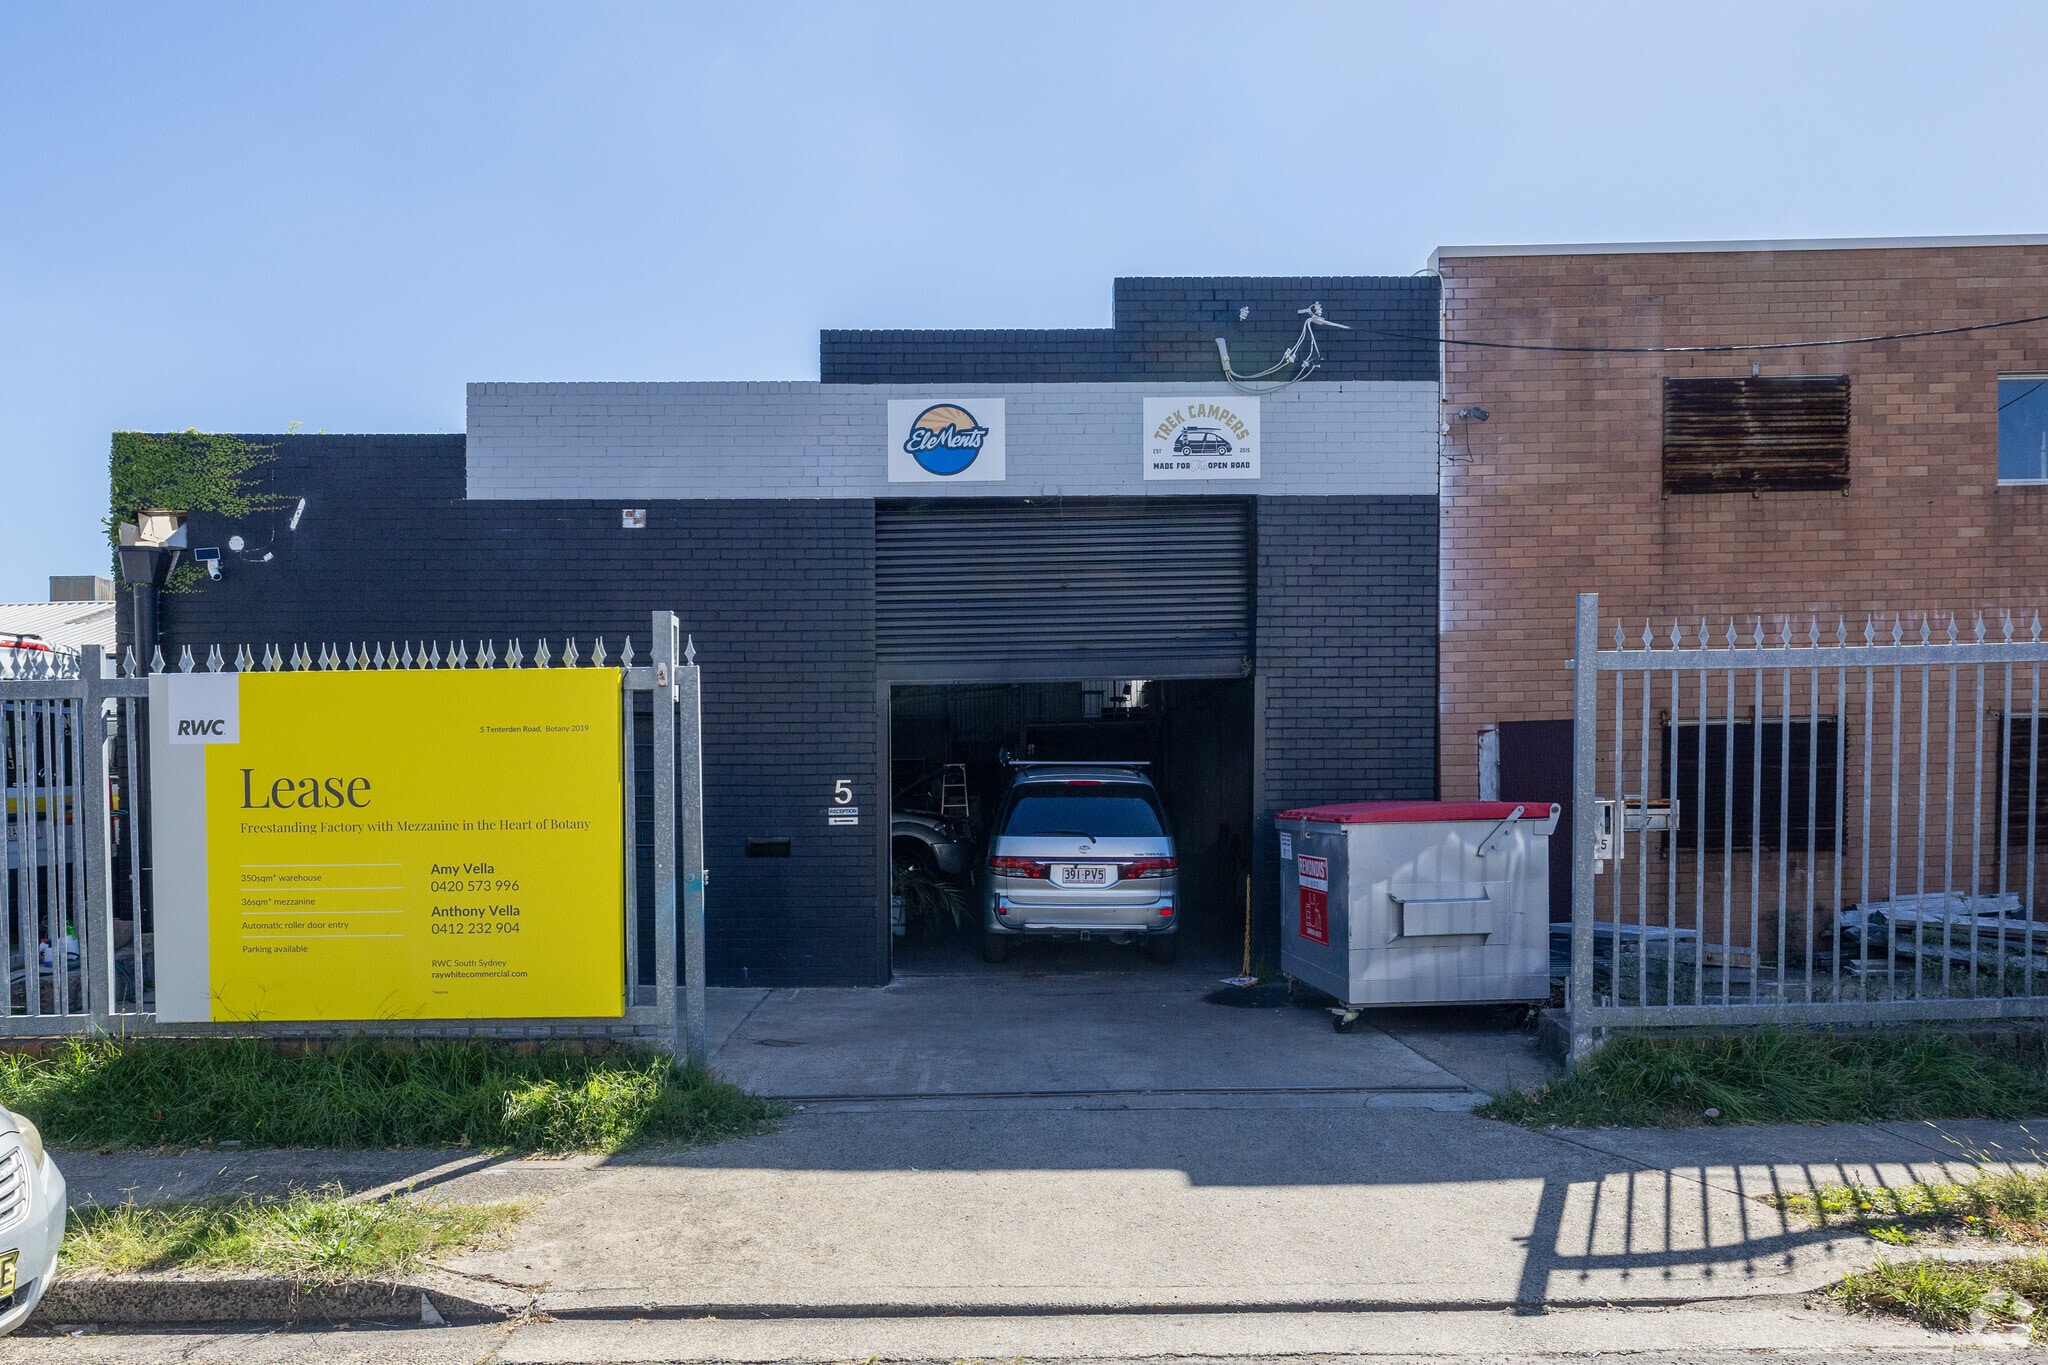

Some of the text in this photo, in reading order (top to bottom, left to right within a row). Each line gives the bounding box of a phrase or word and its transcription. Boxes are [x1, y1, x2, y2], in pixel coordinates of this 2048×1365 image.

[1153, 403, 1250, 441] TREK CAMPERS
[1153, 462, 1174, 470] MADE
[1190, 459, 1208, 472] The
[1207, 461, 1228, 469] OPEN
[1230, 461, 1251, 469] ROAD
[177, 719, 226, 736] RWC
[486, 725, 521, 733] Tenterden
[545, 725, 570, 733] Botany
[571, 724, 589, 732] 2019
[239, 768, 371, 809] Lease
[834, 779, 853, 805] 5
[240, 818, 591, 835] Freestanding Factory with Mezzanine in the Heart of Botany
[1646, 816, 1653, 825] 7
[1601, 839, 1608, 850] 5
[430, 862, 495, 877] Amy Vella
[278, 873, 322, 882] warehouse
[430, 879, 520, 893] 0420 573 996
[273, 898, 316, 906] mezzanine
[431, 904, 521, 919] Anthony Vella
[241, 920, 349, 930] Automatic roller door entry
[431, 922, 521, 935] 0412 232 904
[242, 943, 309, 954] Parking available
[431, 958, 507, 968] RWC South Sydney
[431, 969, 528, 979] raywhitecommercial.com
